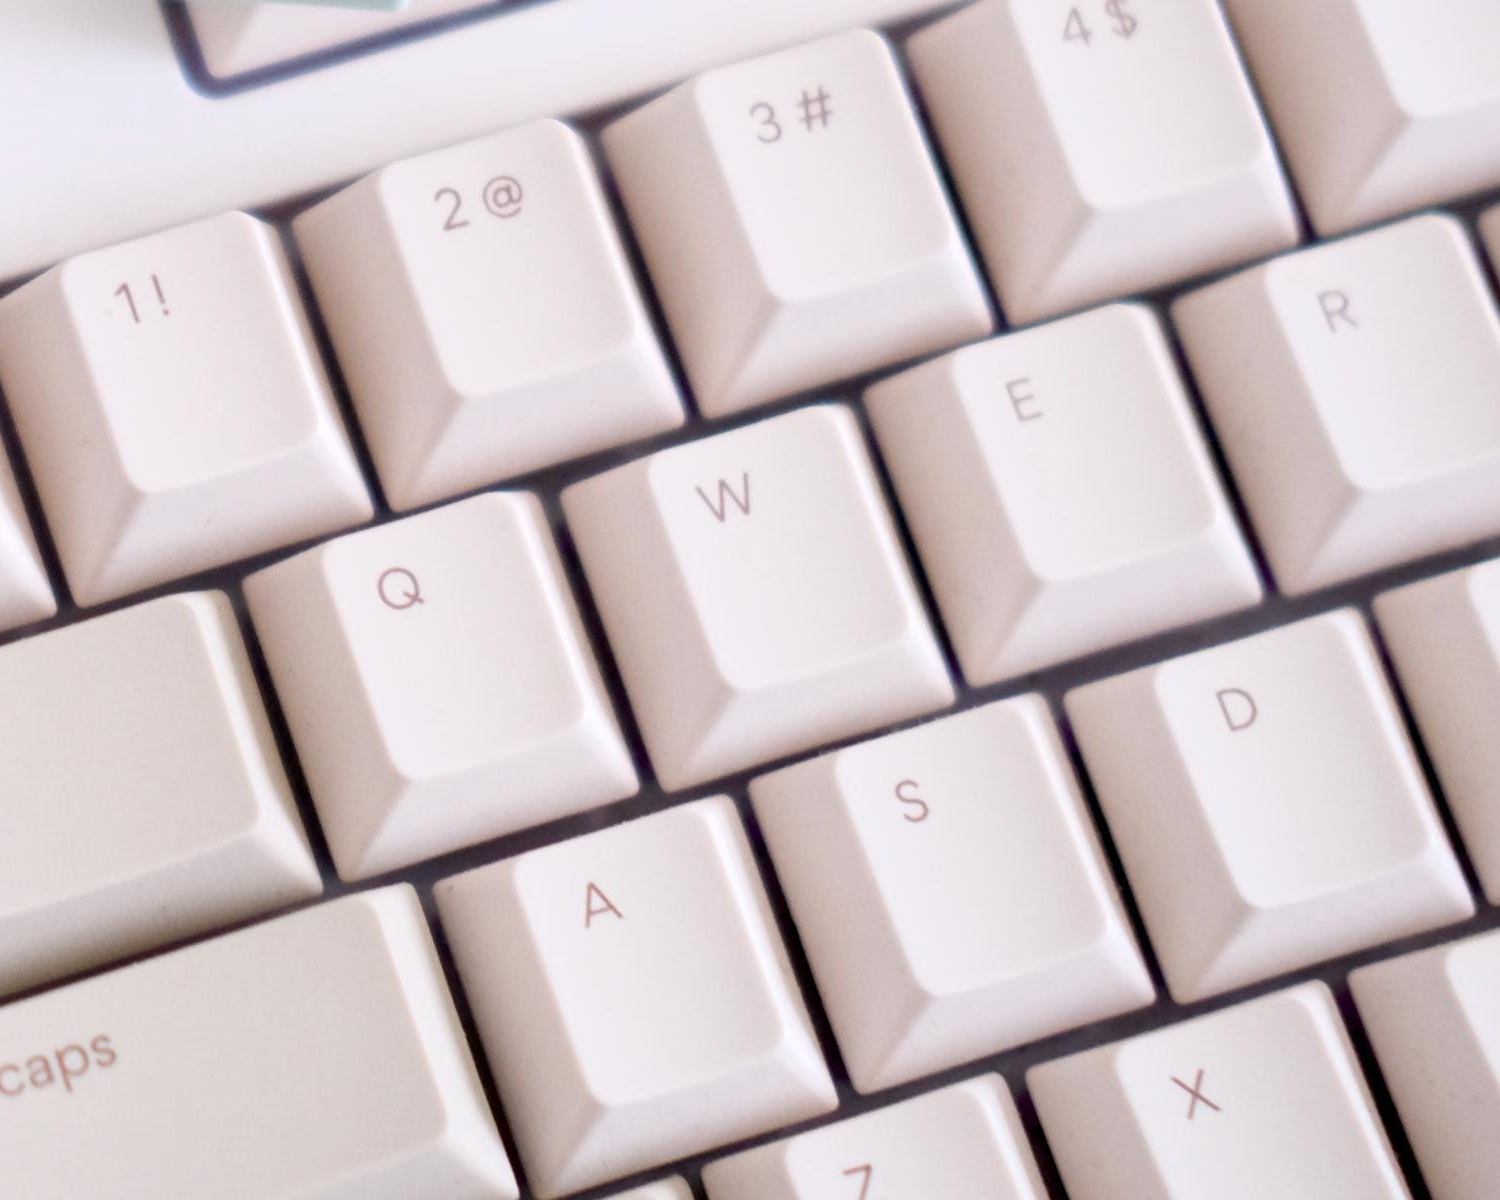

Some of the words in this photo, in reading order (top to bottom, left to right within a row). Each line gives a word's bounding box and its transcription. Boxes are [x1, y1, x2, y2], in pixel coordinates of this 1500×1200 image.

[1314, 287, 1360, 335] R
[1003, 376, 1045, 424] E
[693, 471, 752, 524] W
[374, 565, 426, 612] Q
[1213, 686, 1259, 734] D
[893, 778, 931, 825] S
[583, 880, 625, 930] A
[1169, 1068, 1222, 1121] X
